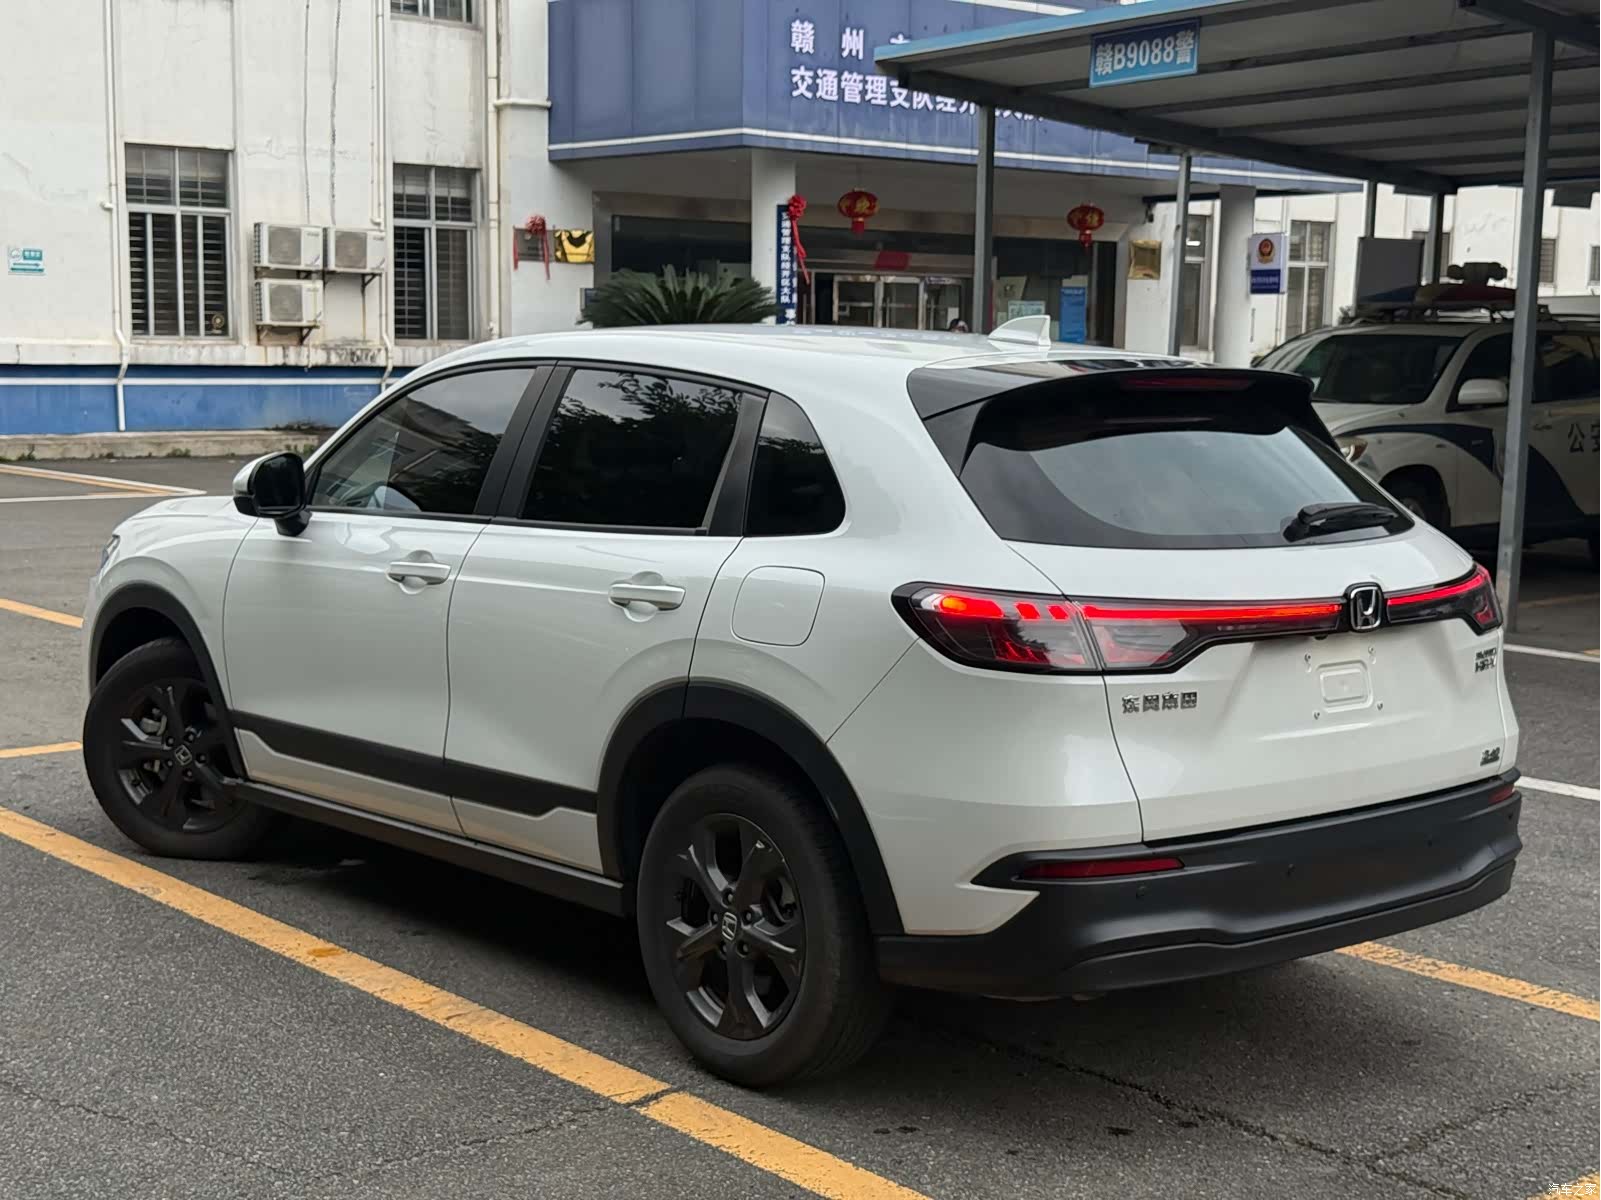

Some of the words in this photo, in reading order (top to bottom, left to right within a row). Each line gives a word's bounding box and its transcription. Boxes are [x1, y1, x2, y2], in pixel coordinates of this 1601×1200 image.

[1095, 30, 1194, 76] 赣B9088警
[790, 64, 1046, 121] 交通管理支队经
[1121, 691, 1198, 714] 东风本田
